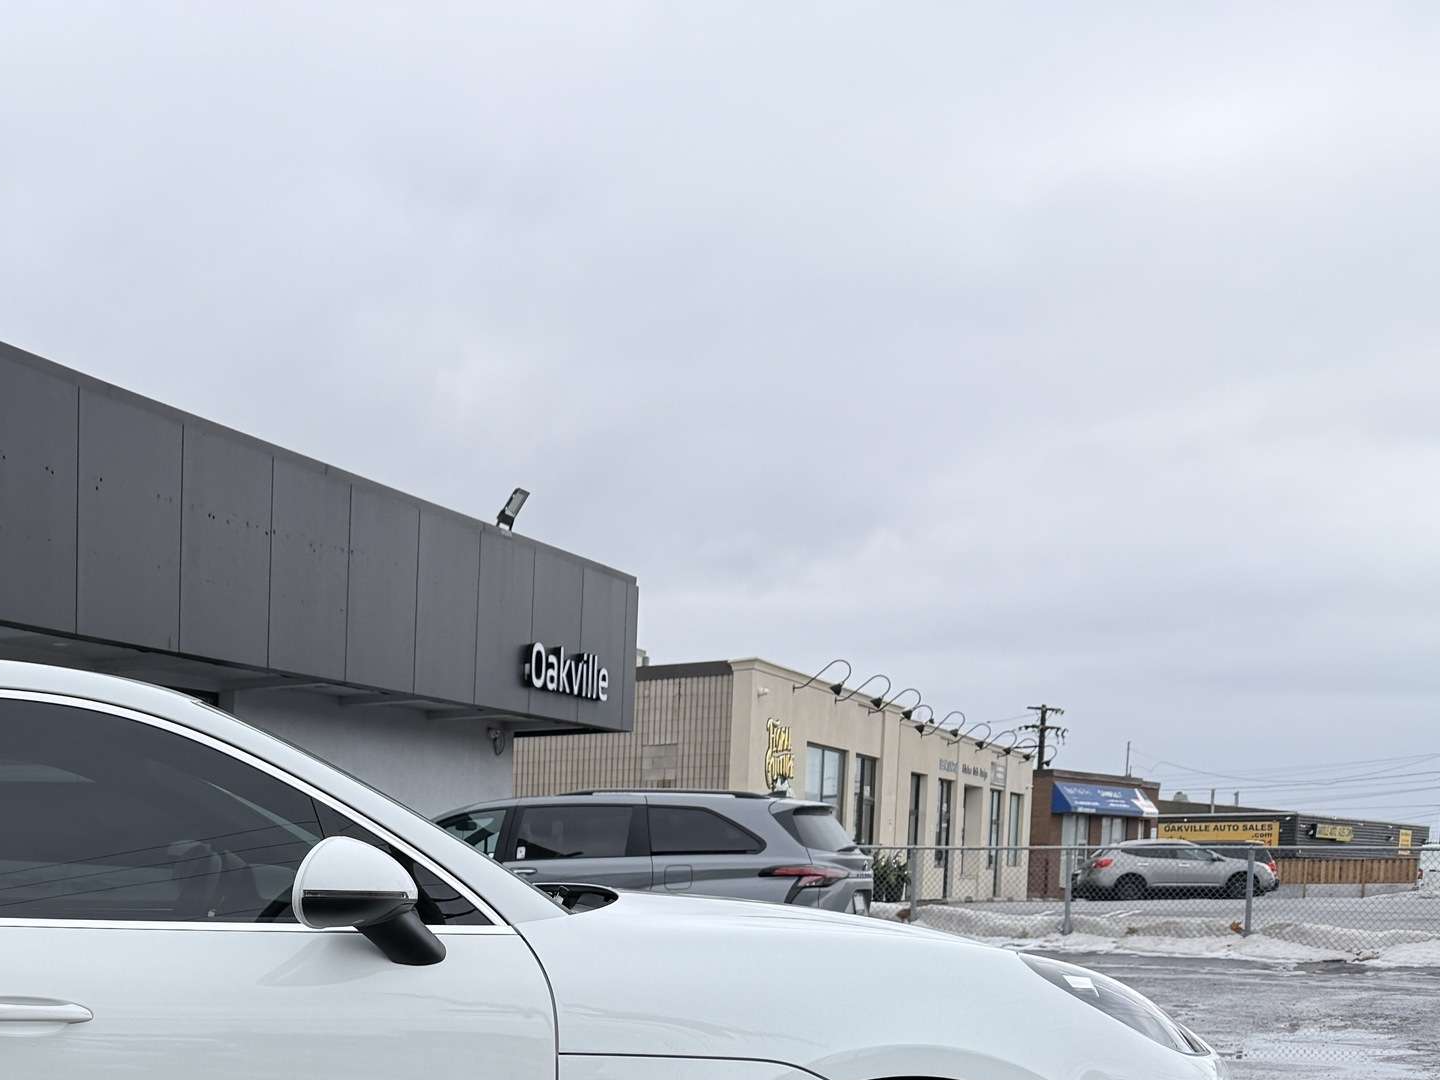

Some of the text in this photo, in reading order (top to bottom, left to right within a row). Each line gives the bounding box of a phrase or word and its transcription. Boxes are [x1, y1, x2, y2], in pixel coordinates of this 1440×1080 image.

[531, 641, 609, 702] Oakville
[1164, 823, 1273, 833] OAKVILLE AUTO SALES
